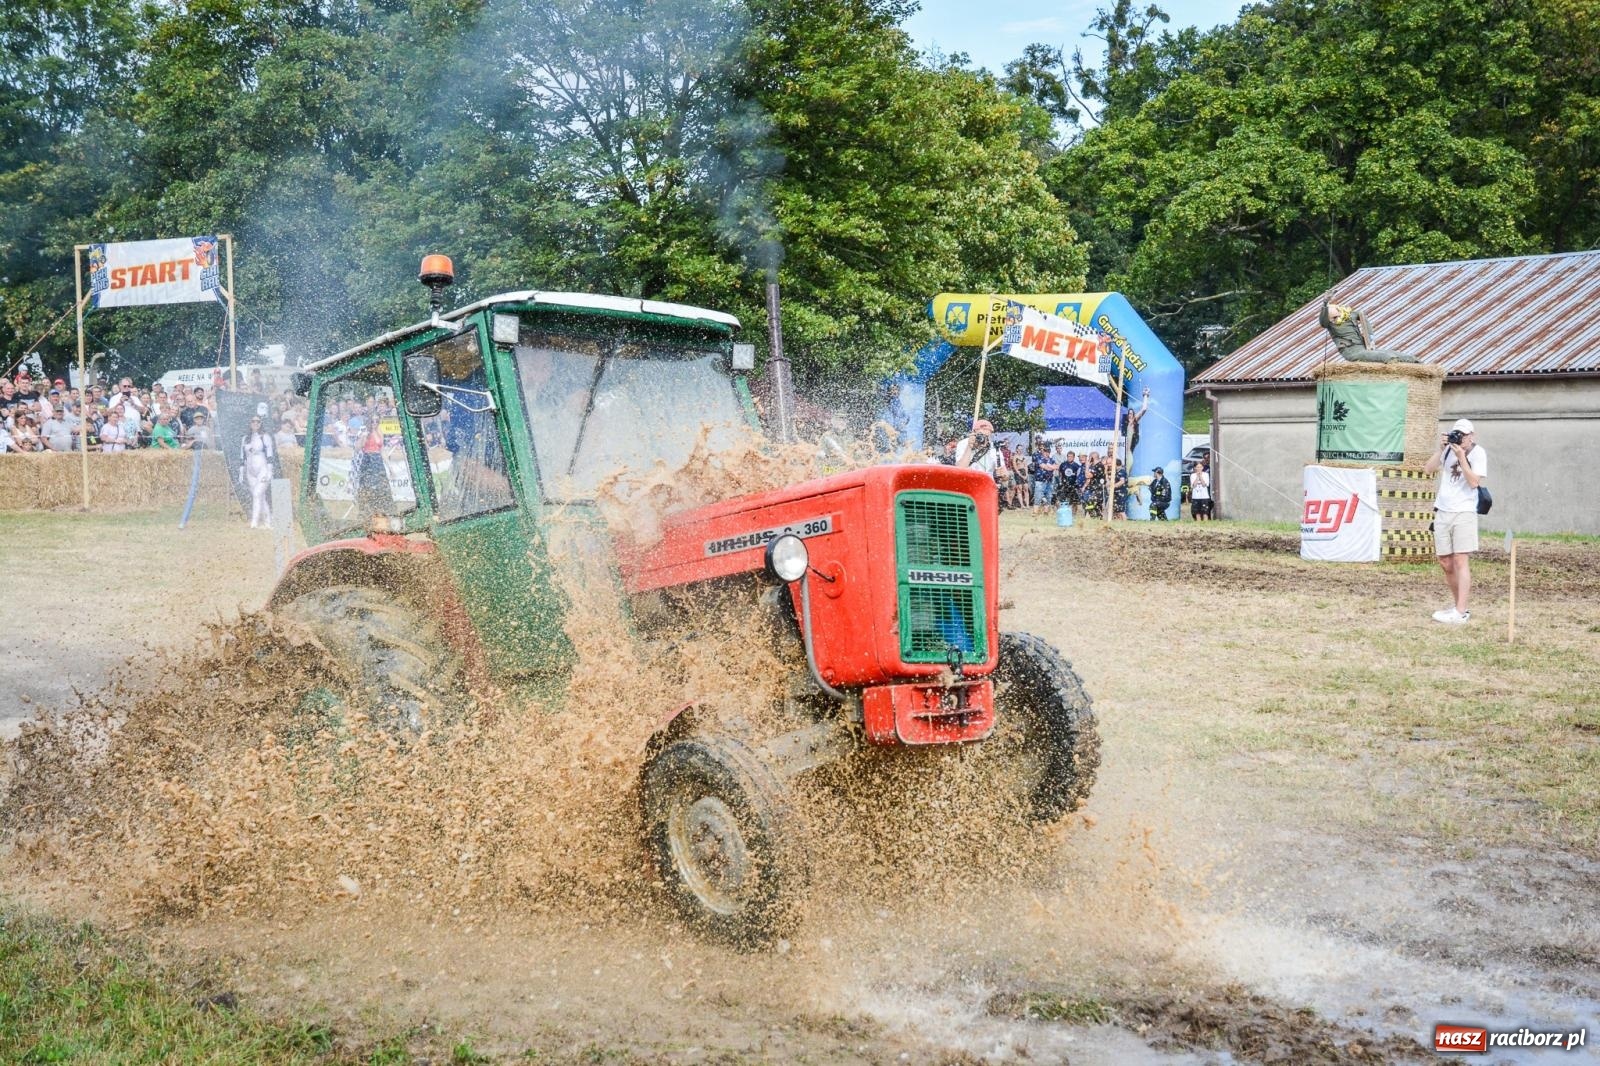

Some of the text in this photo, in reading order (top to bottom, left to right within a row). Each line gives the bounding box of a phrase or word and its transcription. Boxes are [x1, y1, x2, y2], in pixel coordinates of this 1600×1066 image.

[110, 258, 194, 290] START
[1021, 325, 1097, 365] META
[708, 530, 777, 554] URSUS
[908, 571, 972, 583] URSUS
